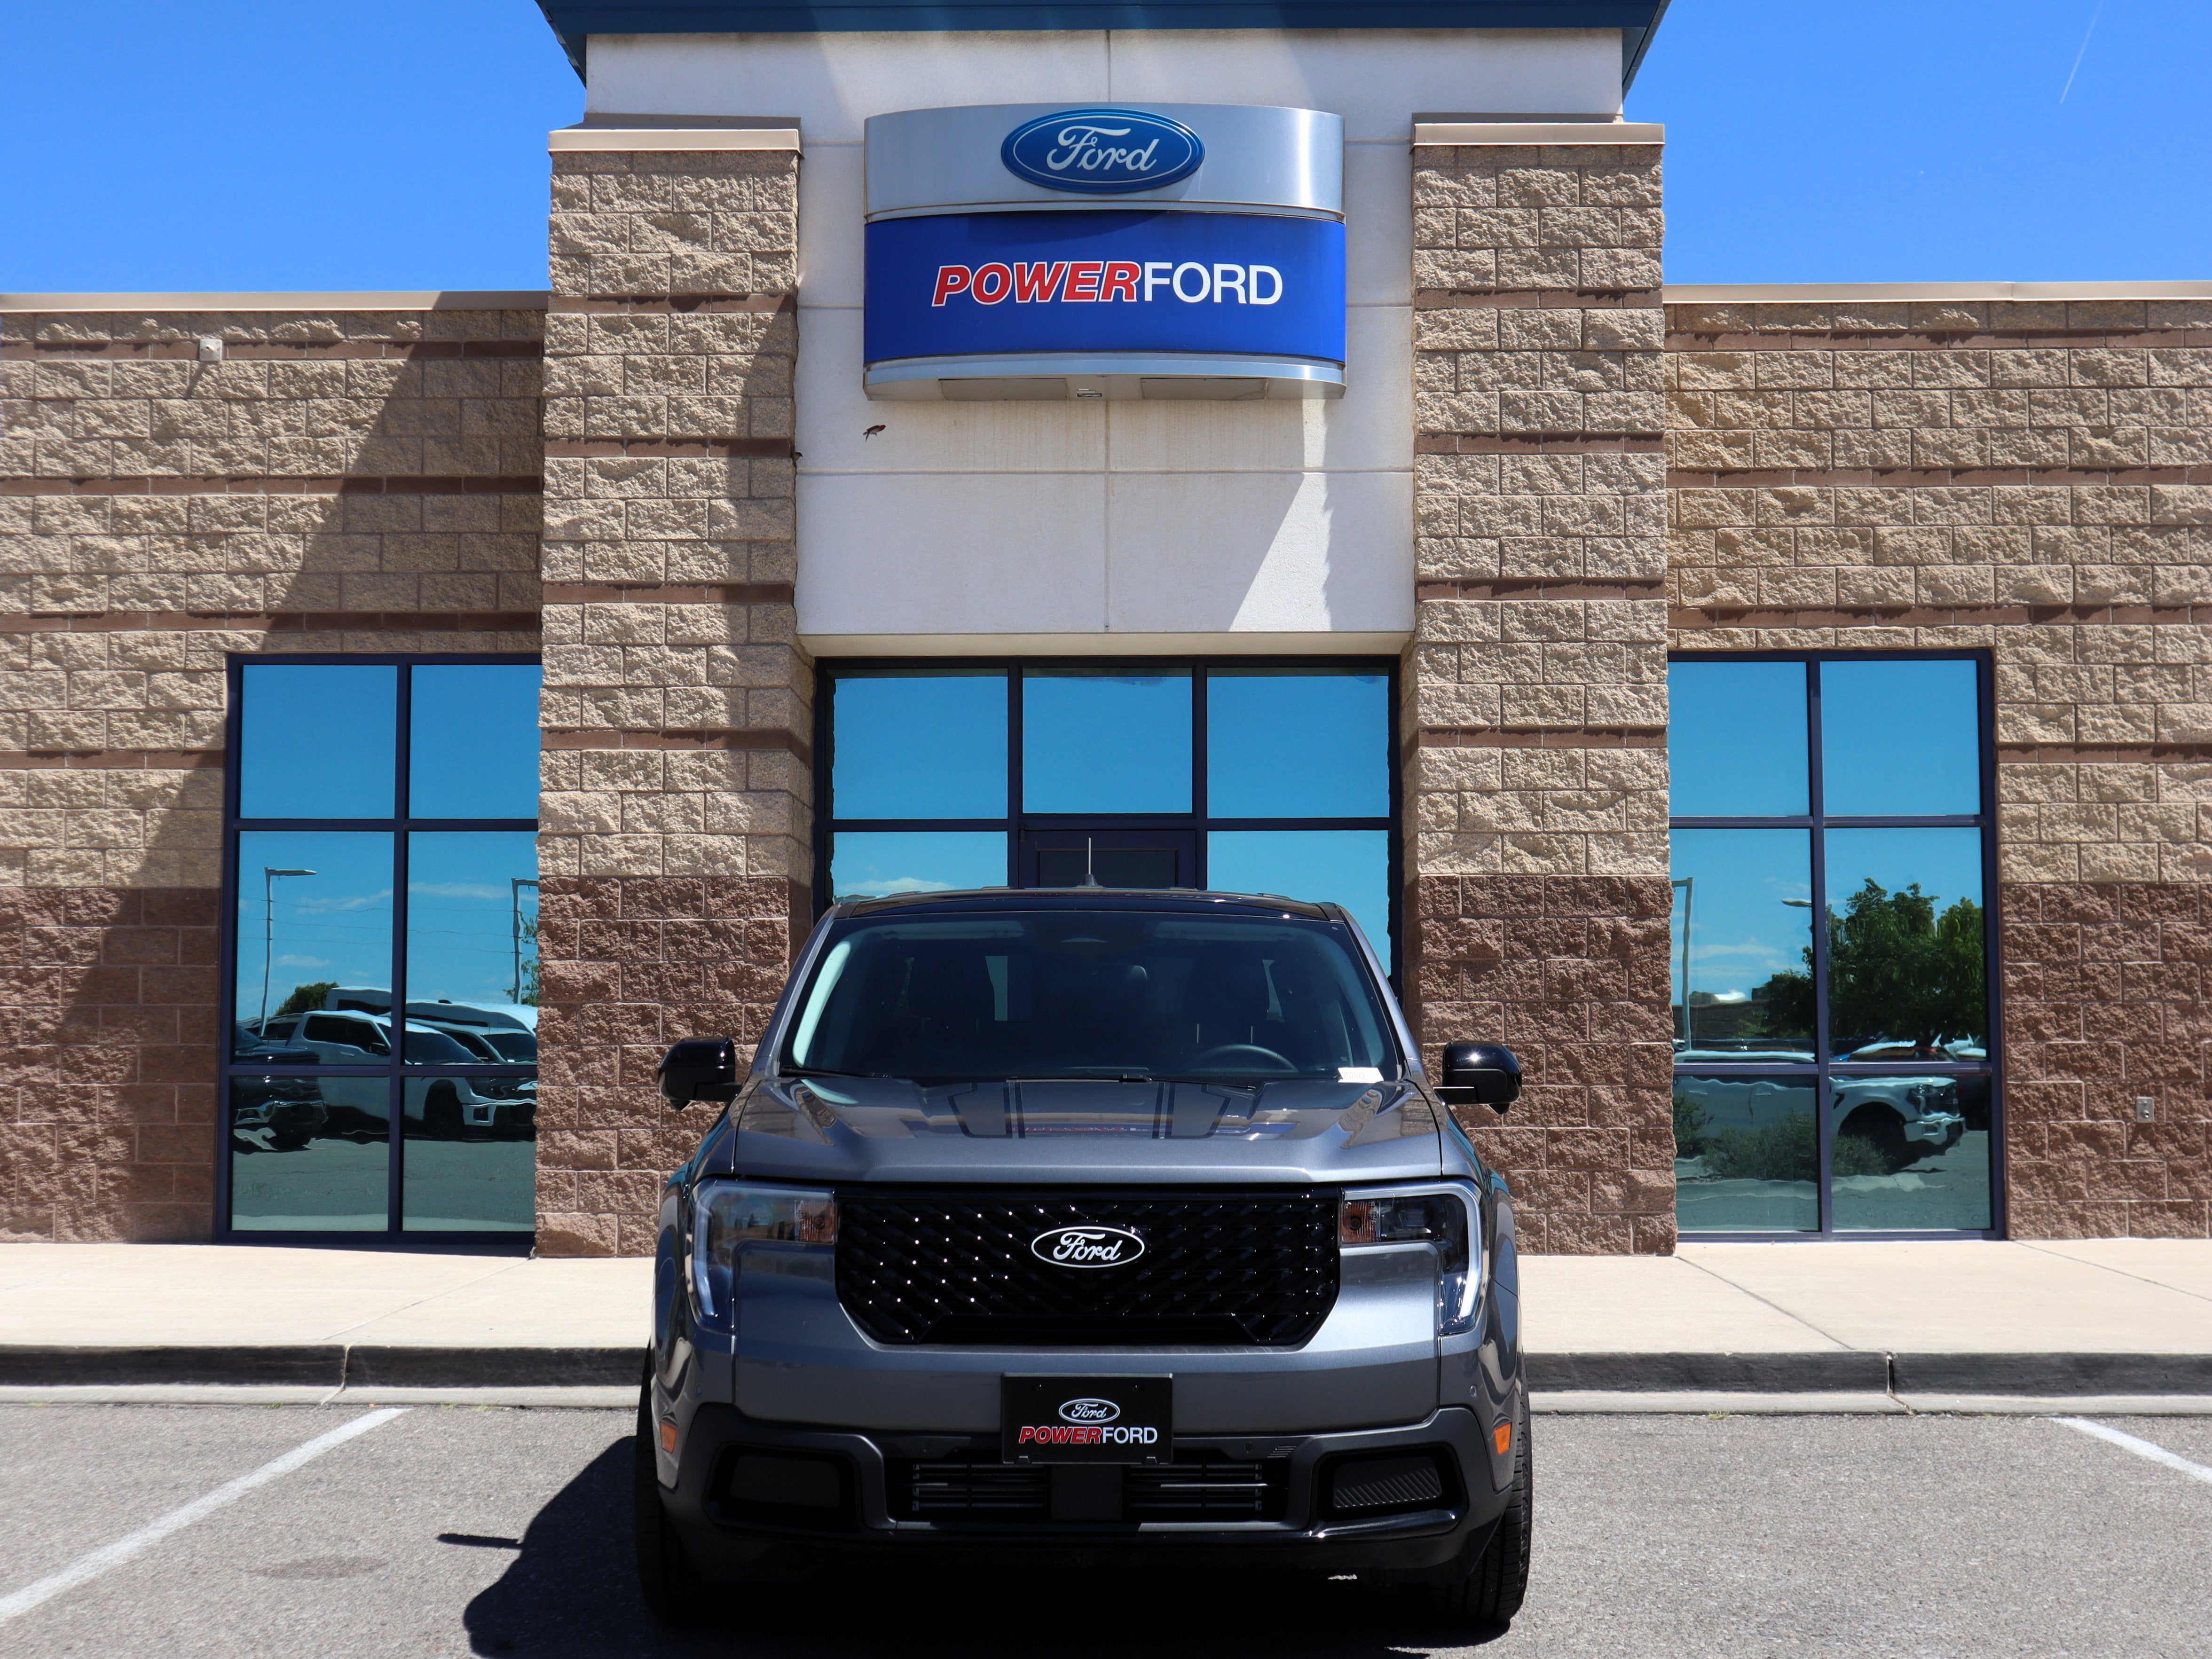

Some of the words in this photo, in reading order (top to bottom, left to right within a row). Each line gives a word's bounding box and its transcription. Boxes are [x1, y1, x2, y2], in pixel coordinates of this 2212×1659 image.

[1047, 125, 1158, 172] Ford
[1053, 1232, 1123, 1261] Ford
[1071, 1403, 1107, 1418] Ford
